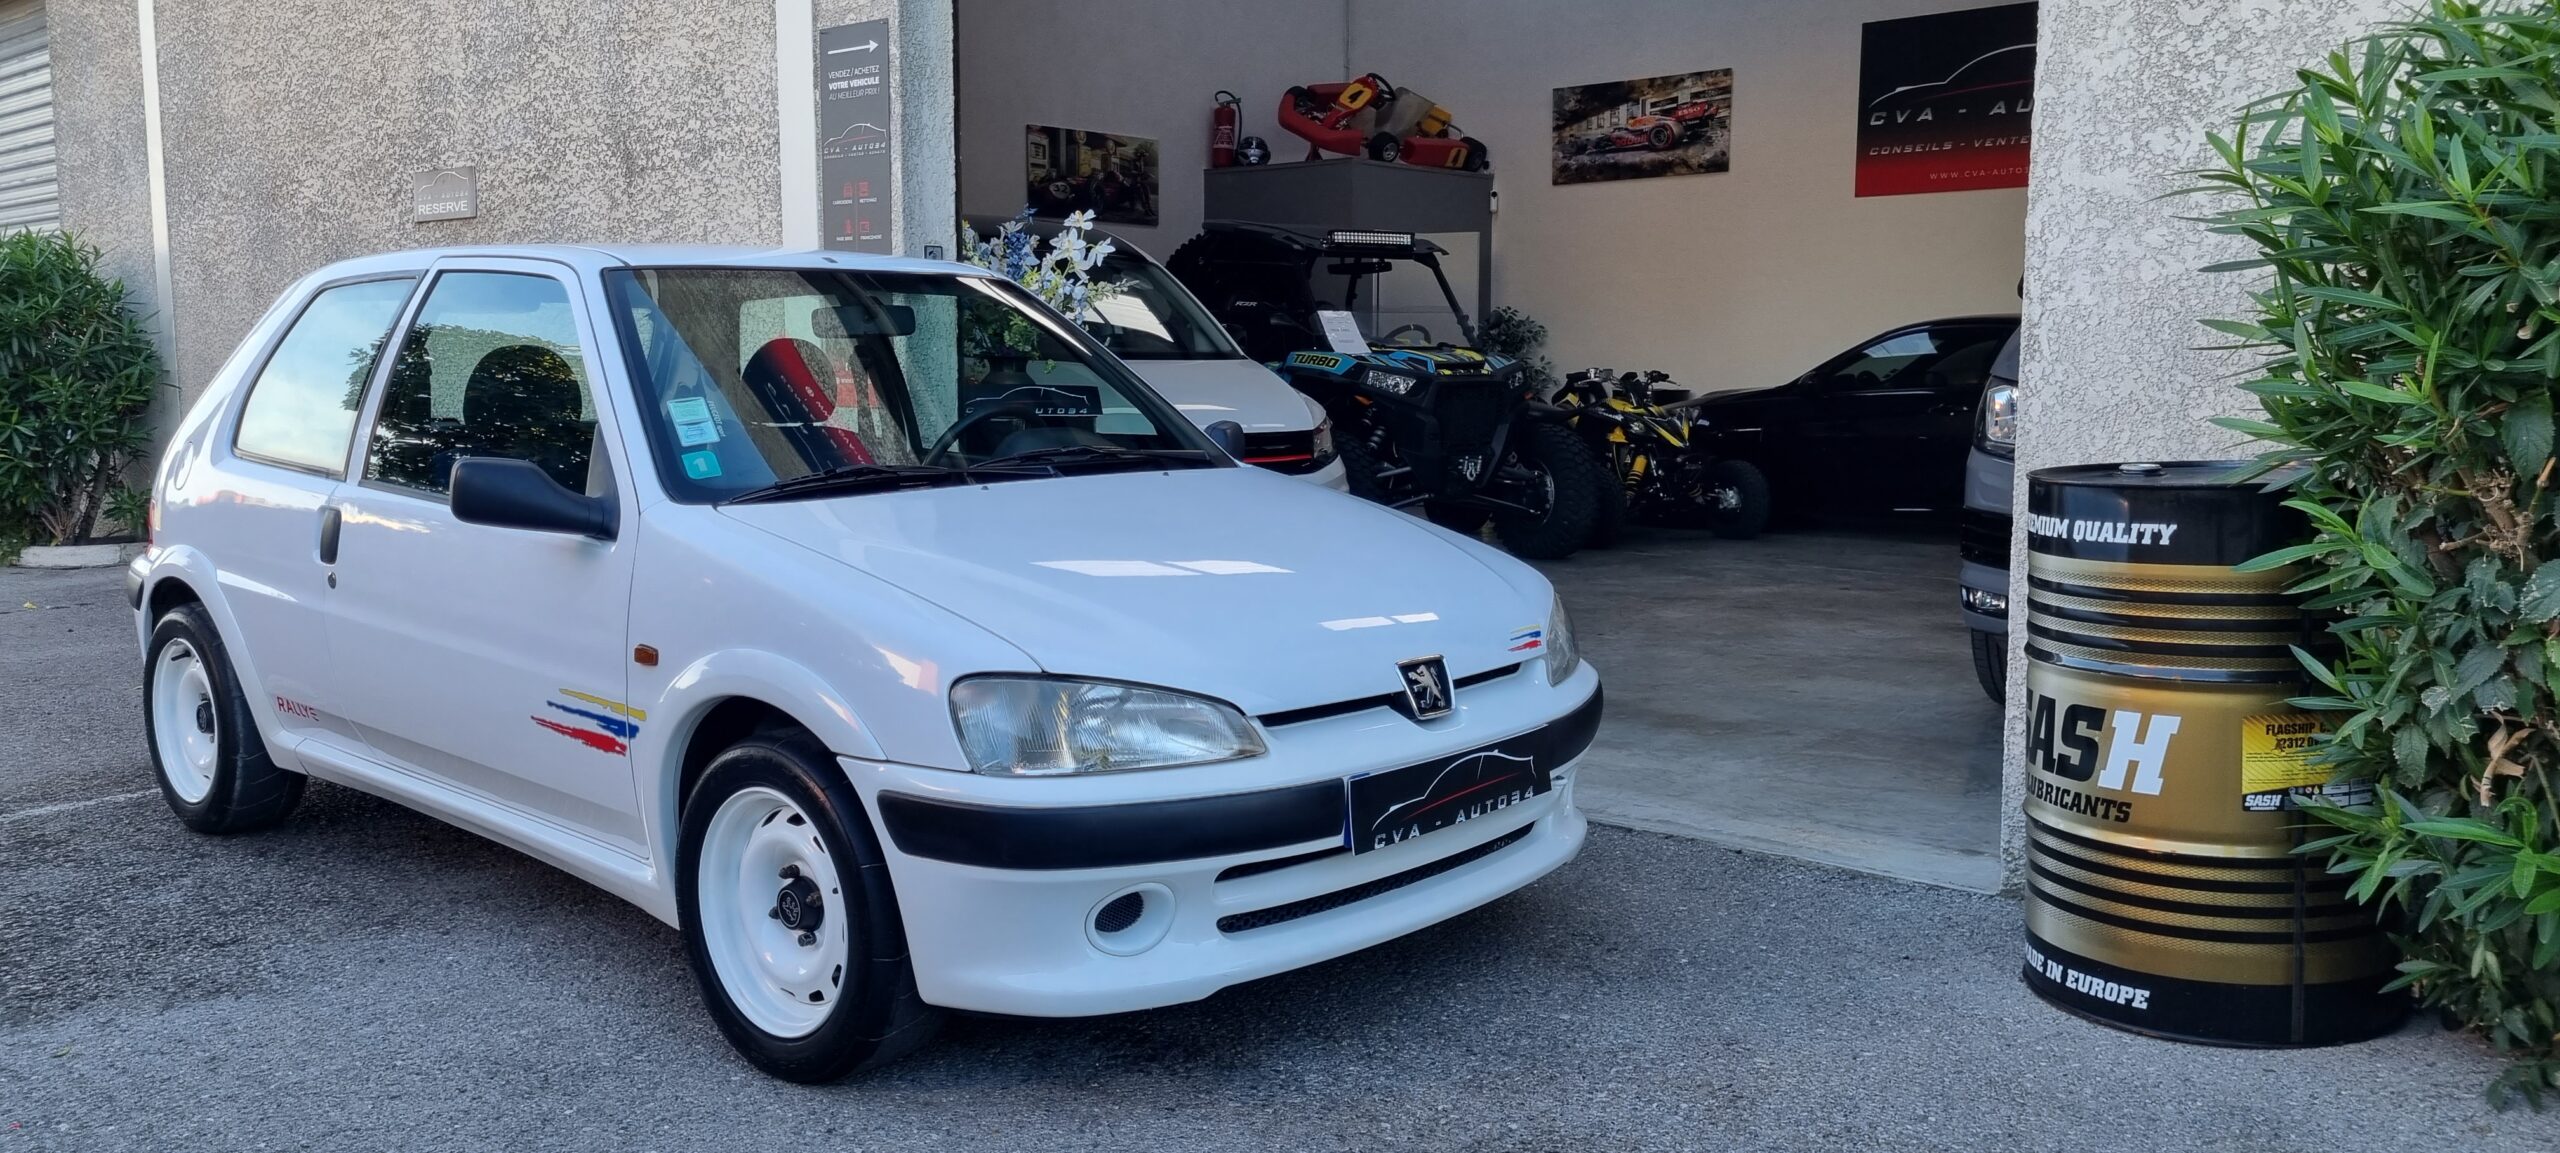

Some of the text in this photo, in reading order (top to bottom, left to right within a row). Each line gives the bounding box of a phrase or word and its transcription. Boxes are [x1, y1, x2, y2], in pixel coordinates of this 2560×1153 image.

[829, 81, 848, 90] VOTRE
[829, 92, 837, 100] AU
[838, 89, 864, 99] MEILLEUR
[1870, 108, 1934, 125] CVA
[852, 142, 886, 151] AUTO34
[1869, 141, 1953, 155] CONSEILS
[1974, 135, 2030, 147] VENTE
[418, 200, 468, 215] RESERVE
[1294, 353, 1340, 368] TURBO
[693, 458, 708, 472] 1
[2073, 520, 2177, 545] QUALITY
[277, 696, 319, 721] RALLYE
[2266, 723, 2315, 737] FLAGSHIP
[2244, 794, 2282, 806] SASH
[1374, 824, 1420, 849] CVA
[1455, 786, 1534, 824] AUTO34
[2046, 960, 2063, 983] IN
[2066, 969, 2150, 1010] EUROPE
